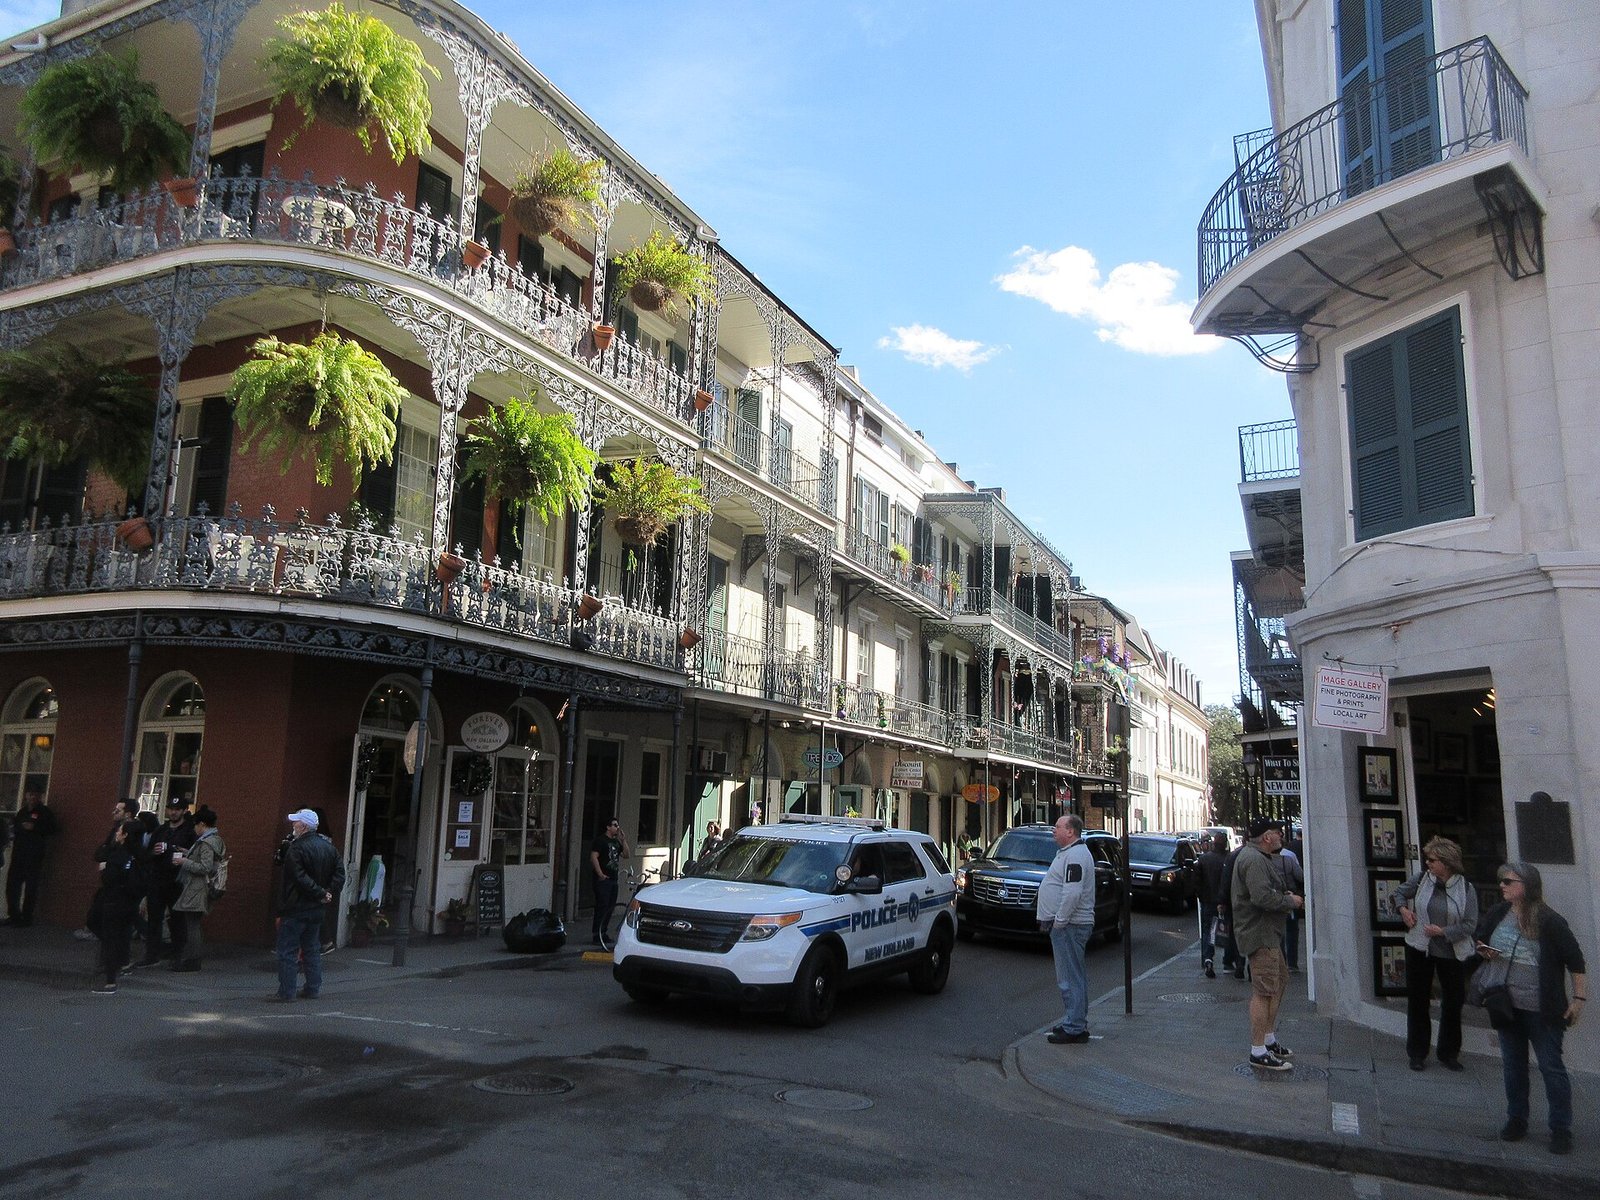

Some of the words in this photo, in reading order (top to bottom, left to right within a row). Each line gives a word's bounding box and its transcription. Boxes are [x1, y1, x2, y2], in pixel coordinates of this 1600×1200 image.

[1321, 675, 1346, 686] IMAGE
[1347, 679, 1382, 691] GALLERY
[1321, 687, 1335, 696] FINE
[1336, 689, 1381, 702] PHOTOGRAPHY
[1343, 699, 1364, 708] PRINTS
[1333, 709, 1353, 718] LOCAL
[468, 714, 503, 730] FOREVER
[1265, 781, 1283, 791] NEW
[851, 904, 898, 933] POLICE
[864, 945, 883, 963] NEW
[882, 936, 915, 957] ORLEANS
